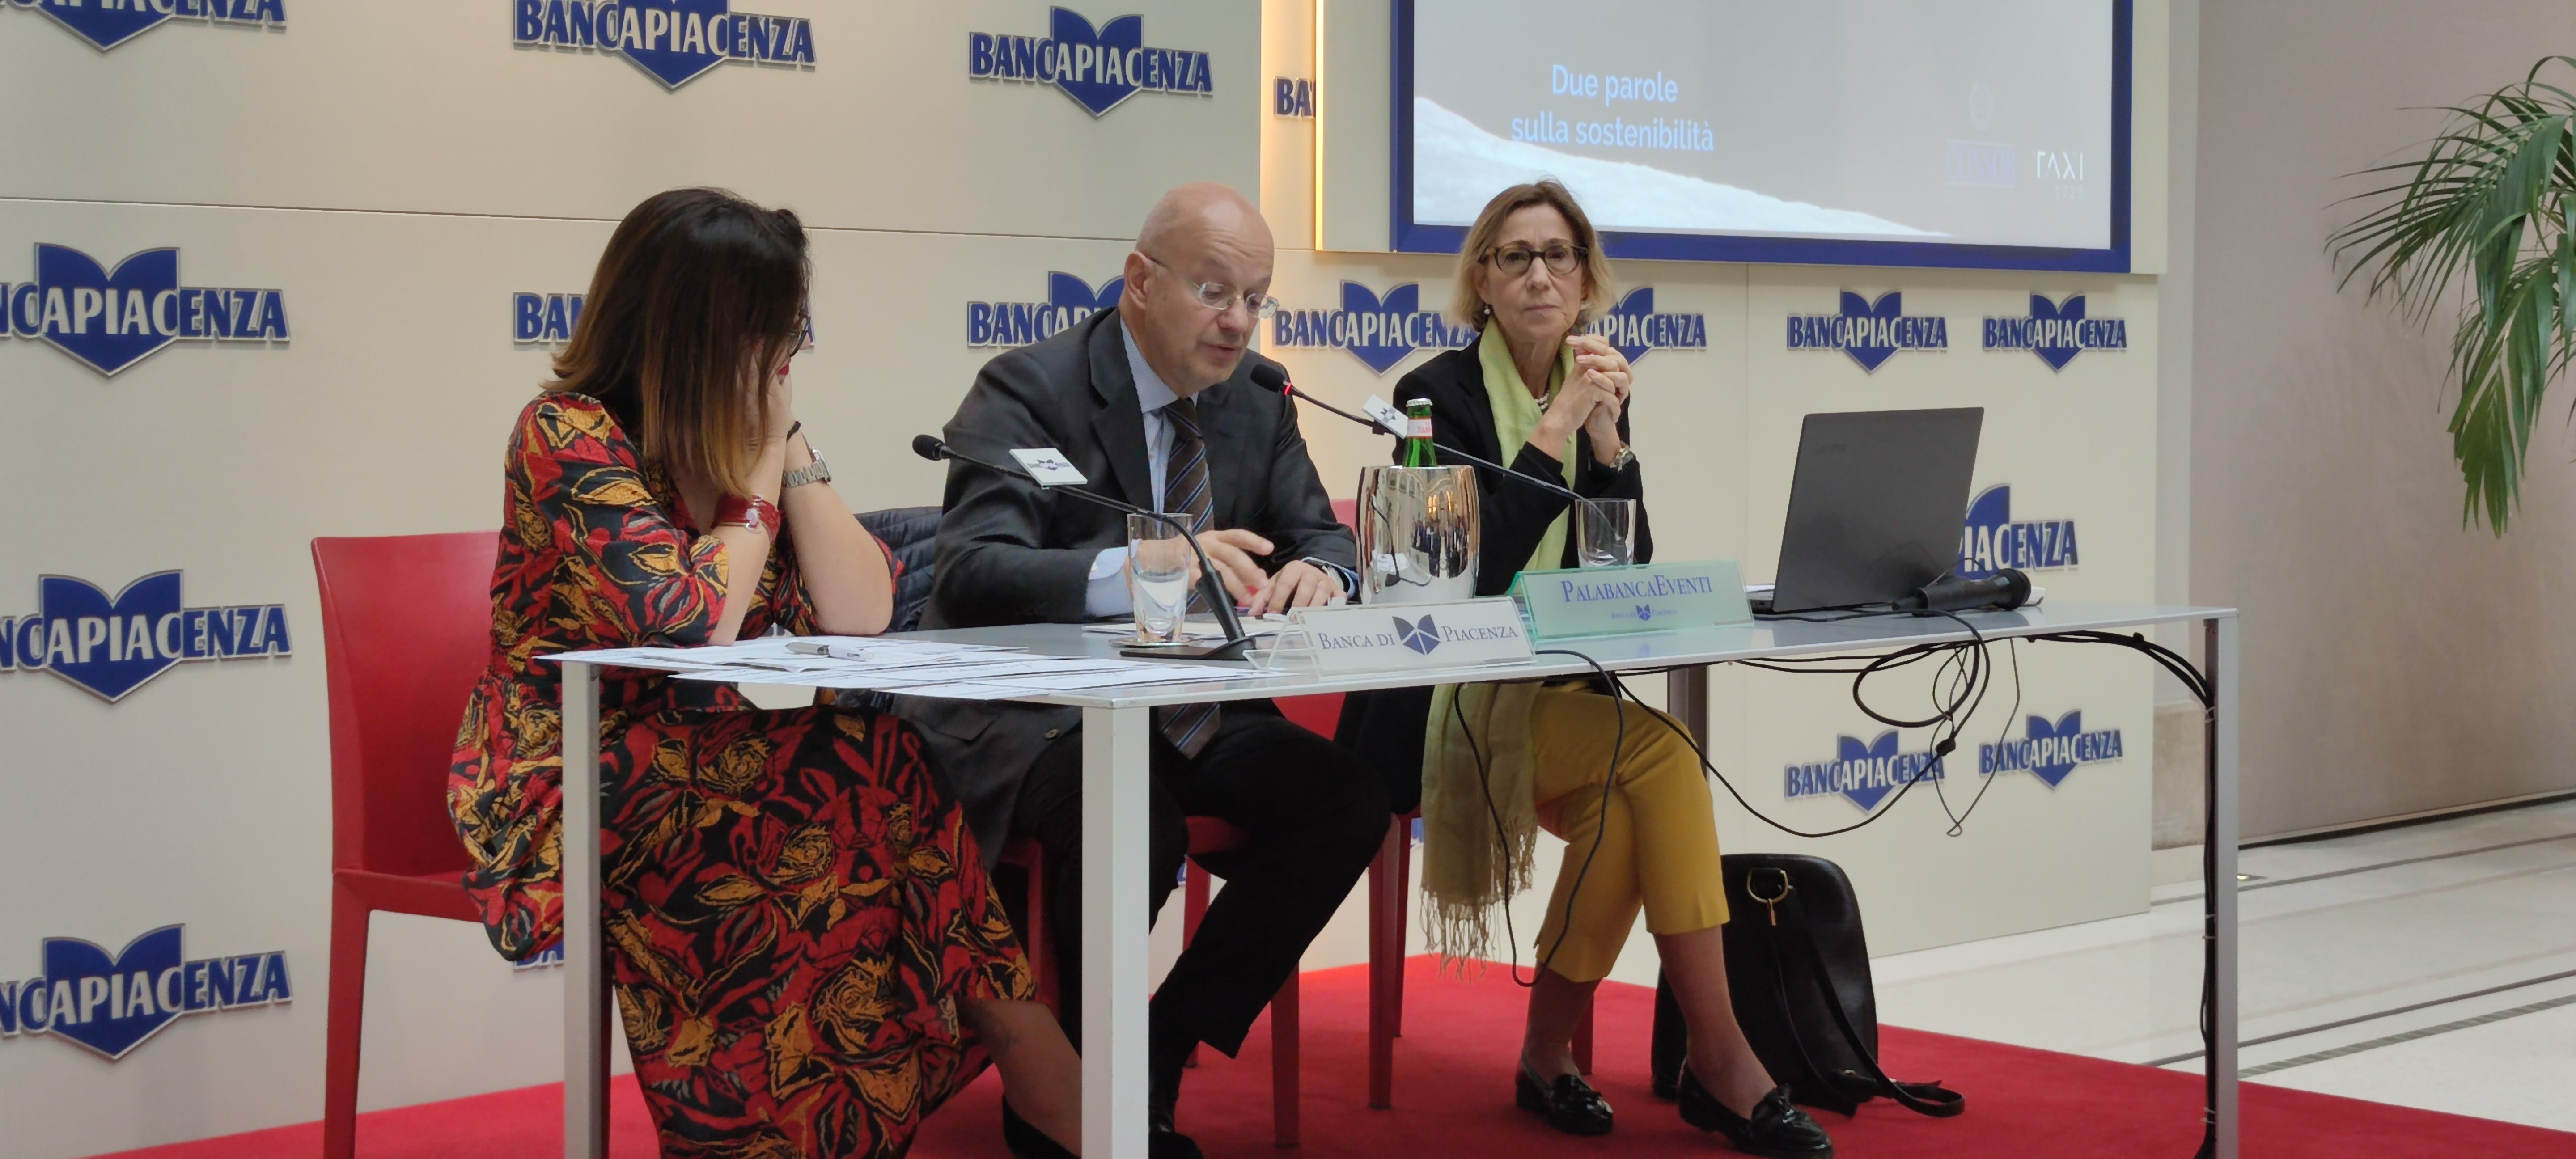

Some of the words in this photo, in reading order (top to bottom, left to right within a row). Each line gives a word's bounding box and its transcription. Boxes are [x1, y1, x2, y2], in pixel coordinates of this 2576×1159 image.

[970, 34, 1213, 92] BANCAPIACENZA
[1552, 64, 1599, 97] Due
[1605, 71, 1678, 107] parole
[1511, 110, 1569, 143] sulla
[1576, 116, 1714, 152] sostenibilità
[0, 284, 290, 338] CAPIACENZA
[1588, 313, 1707, 348] APIACENZA
[1788, 315, 1948, 348] BANCAPIACENZA
[1984, 317, 2127, 349] BANCAPIACENZA
[1959, 520, 2079, 573] IACENZA
[1317, 632, 1374, 650] BANCA
[1376, 633, 1396, 646] DI
[1441, 626, 1519, 642] PIACENZA
[1982, 729, 2123, 774] BANCAPIACENZA
[0, 951, 292, 1033] NCAPIACENZA
